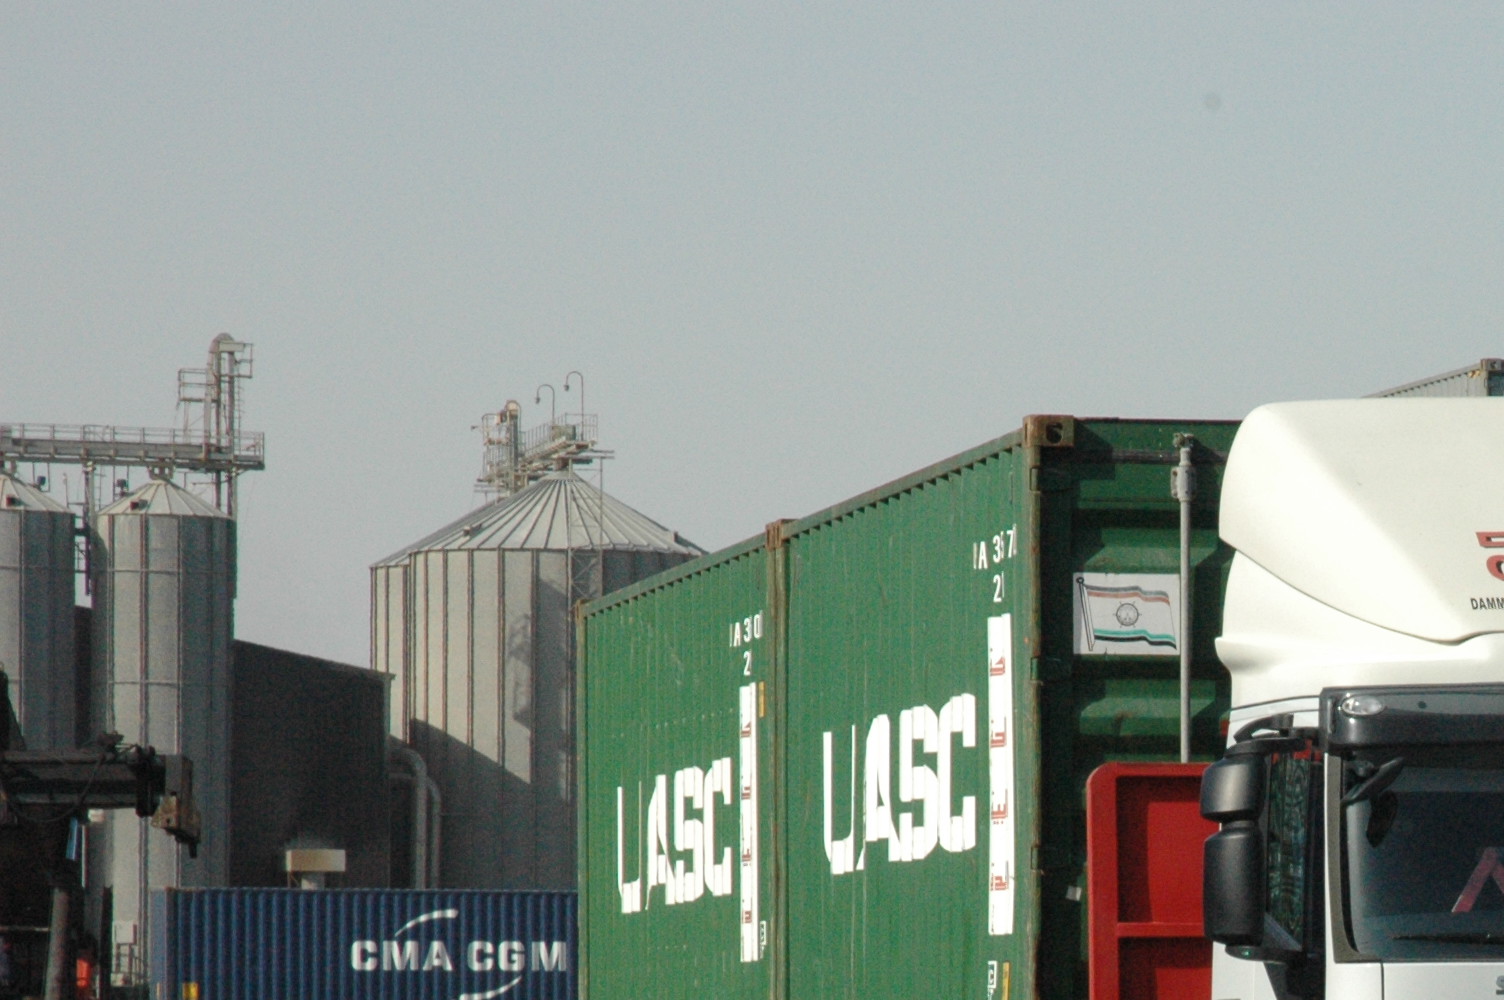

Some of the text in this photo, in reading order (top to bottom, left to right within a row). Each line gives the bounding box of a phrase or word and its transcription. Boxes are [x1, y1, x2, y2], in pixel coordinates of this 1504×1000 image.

[617, 757, 732, 914] UASC
[824, 693, 977, 875] UASC
[351, 940, 567, 972] CMA CGM
